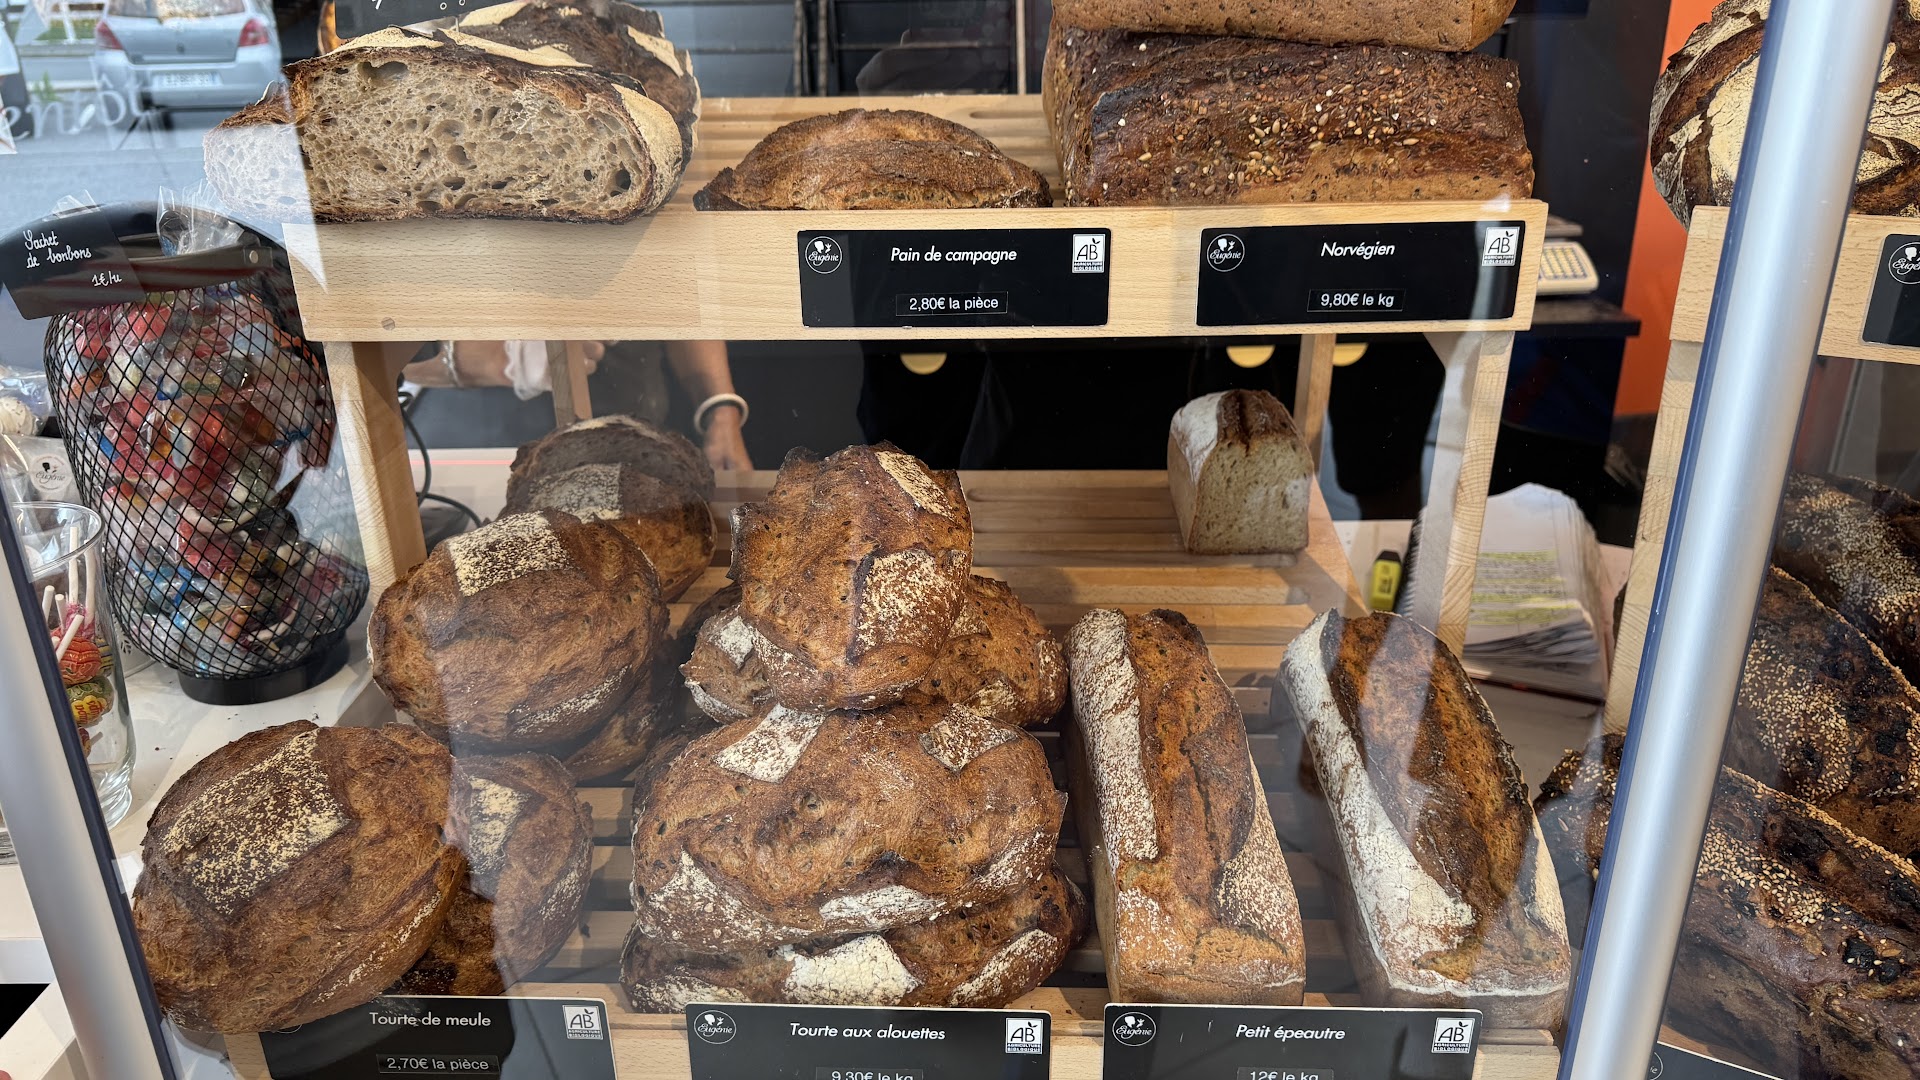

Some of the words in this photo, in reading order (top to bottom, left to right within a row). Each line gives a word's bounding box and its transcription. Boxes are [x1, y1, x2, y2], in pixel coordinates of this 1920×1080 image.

[22, 230, 59, 250] Sachet
[1487, 236, 1511, 254] AB
[26, 252, 40, 269] de
[46, 244, 92, 263] bonbons
[808, 250, 840, 267] Eugénie
[890, 247, 920, 262] Pain
[924, 245, 942, 262] de
[945, 250, 1017, 266] campagne
[1076, 244, 1099, 261] AB
[1209, 249, 1242, 265] Eugénie
[1321, 242, 1396, 260] Norvégien
[909, 298, 945, 311] 2,80€
[949, 297, 961, 311] la
[965, 296, 999, 312] pièce
[1321, 293, 1359, 307] 9,80€
[1362, 292, 1374, 305] le
[1378, 292, 1395, 308] kg
[369, 1012, 417, 1026] Tourte
[422, 1011, 441, 1026] de
[445, 1013, 491, 1027] meule
[570, 1013, 595, 1029] AB
[698, 1022, 733, 1037] Eugénie
[790, 1023, 838, 1039] Tourte
[842, 1026, 873, 1039] aux
[876, 1024, 946, 1041] alouettes
[1010, 1027, 1035, 1042] AB
[1116, 1025, 1152, 1040] Eugénie
[1235, 1024, 1269, 1039] Petit
[1273, 1024, 1346, 1042] épeautre
[1437, 1026, 1465, 1042] AB
[387, 1056, 429, 1071] 2,70€
[432, 1057, 446, 1070] la
[450, 1056, 489, 1073] pièce
[1249, 1071, 1279, 1080] 12€
